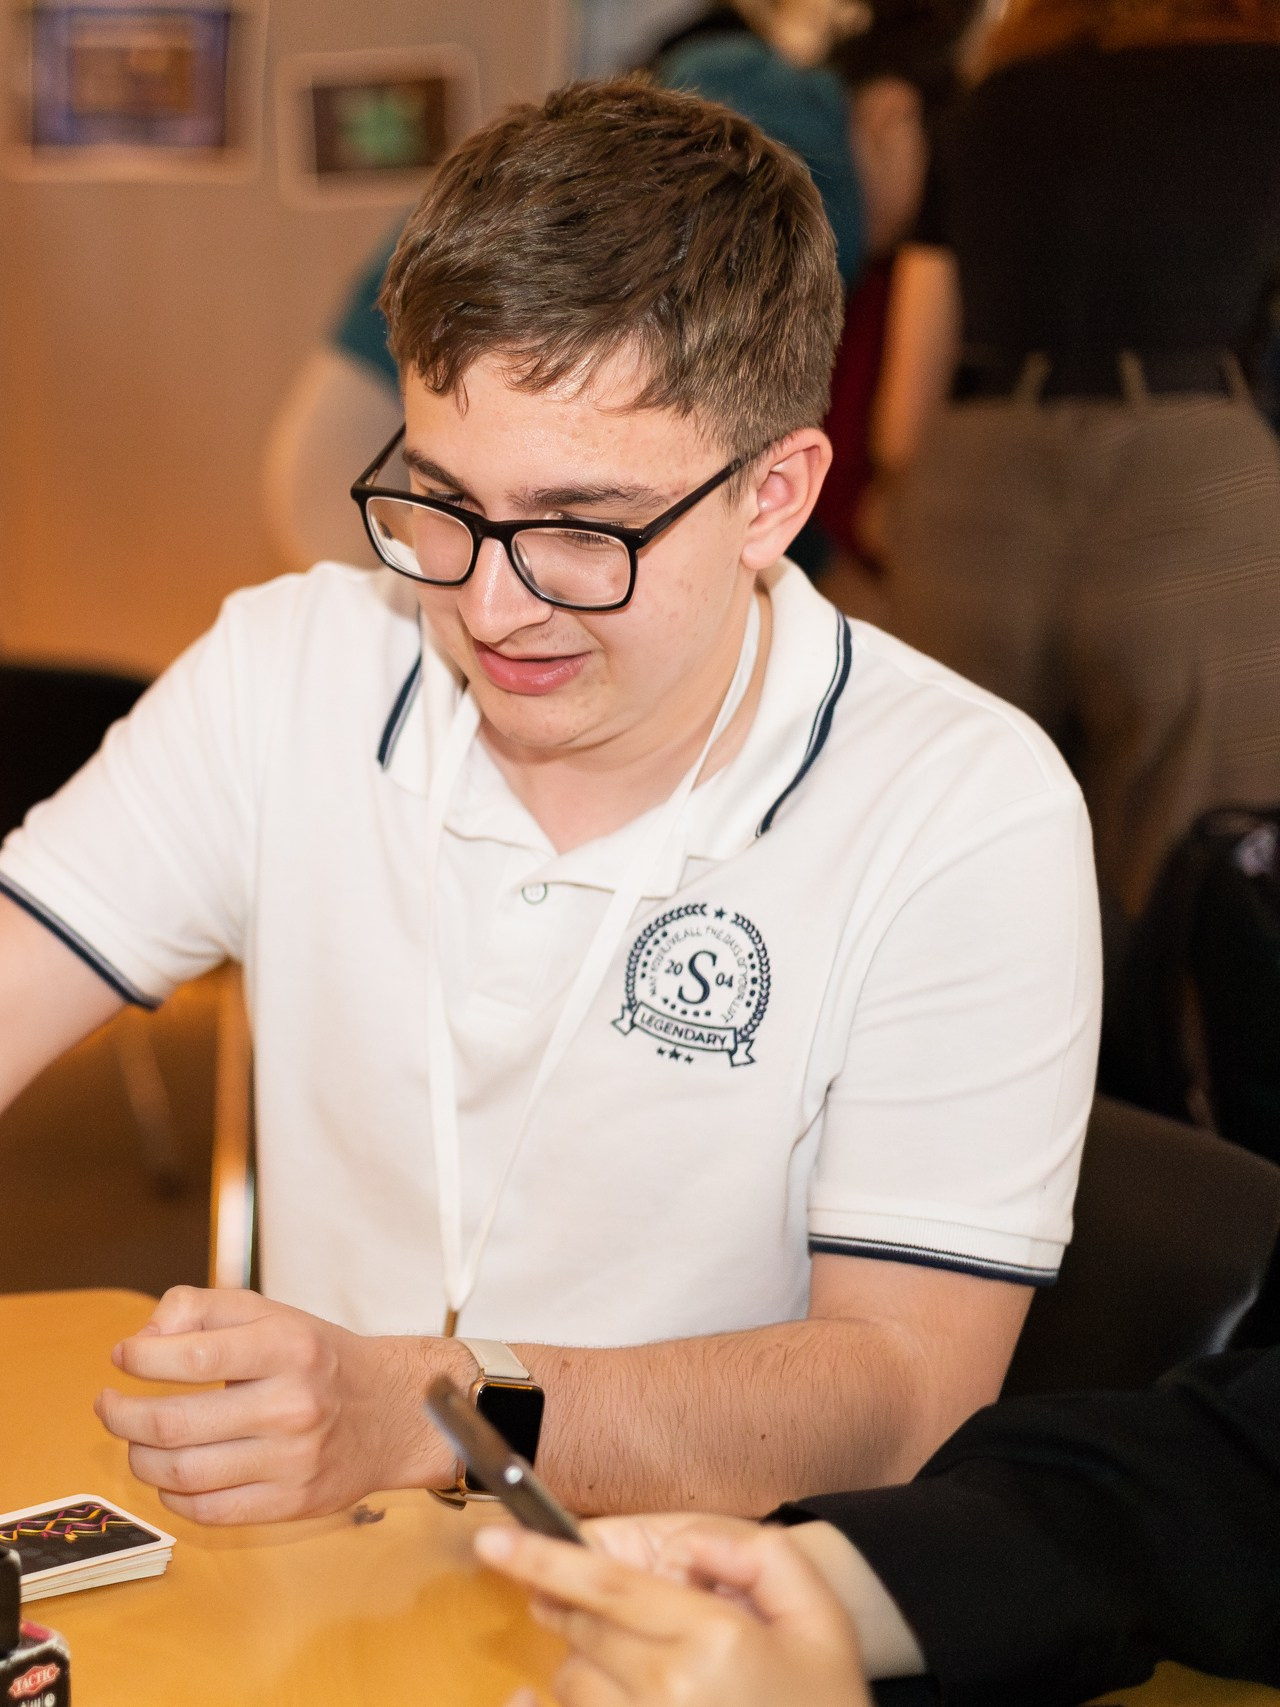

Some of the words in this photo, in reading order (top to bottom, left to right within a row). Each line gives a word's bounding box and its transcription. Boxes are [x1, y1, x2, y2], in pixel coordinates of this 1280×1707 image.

[681, 927, 701, 937] ALL
[665, 960, 683, 975] 20
[678, 950, 717, 1005] S
[715, 972, 733, 988] 04
[640, 1012, 727, 1046] LEGENDARY
[14, 1666, 56, 1695] TACTIC
